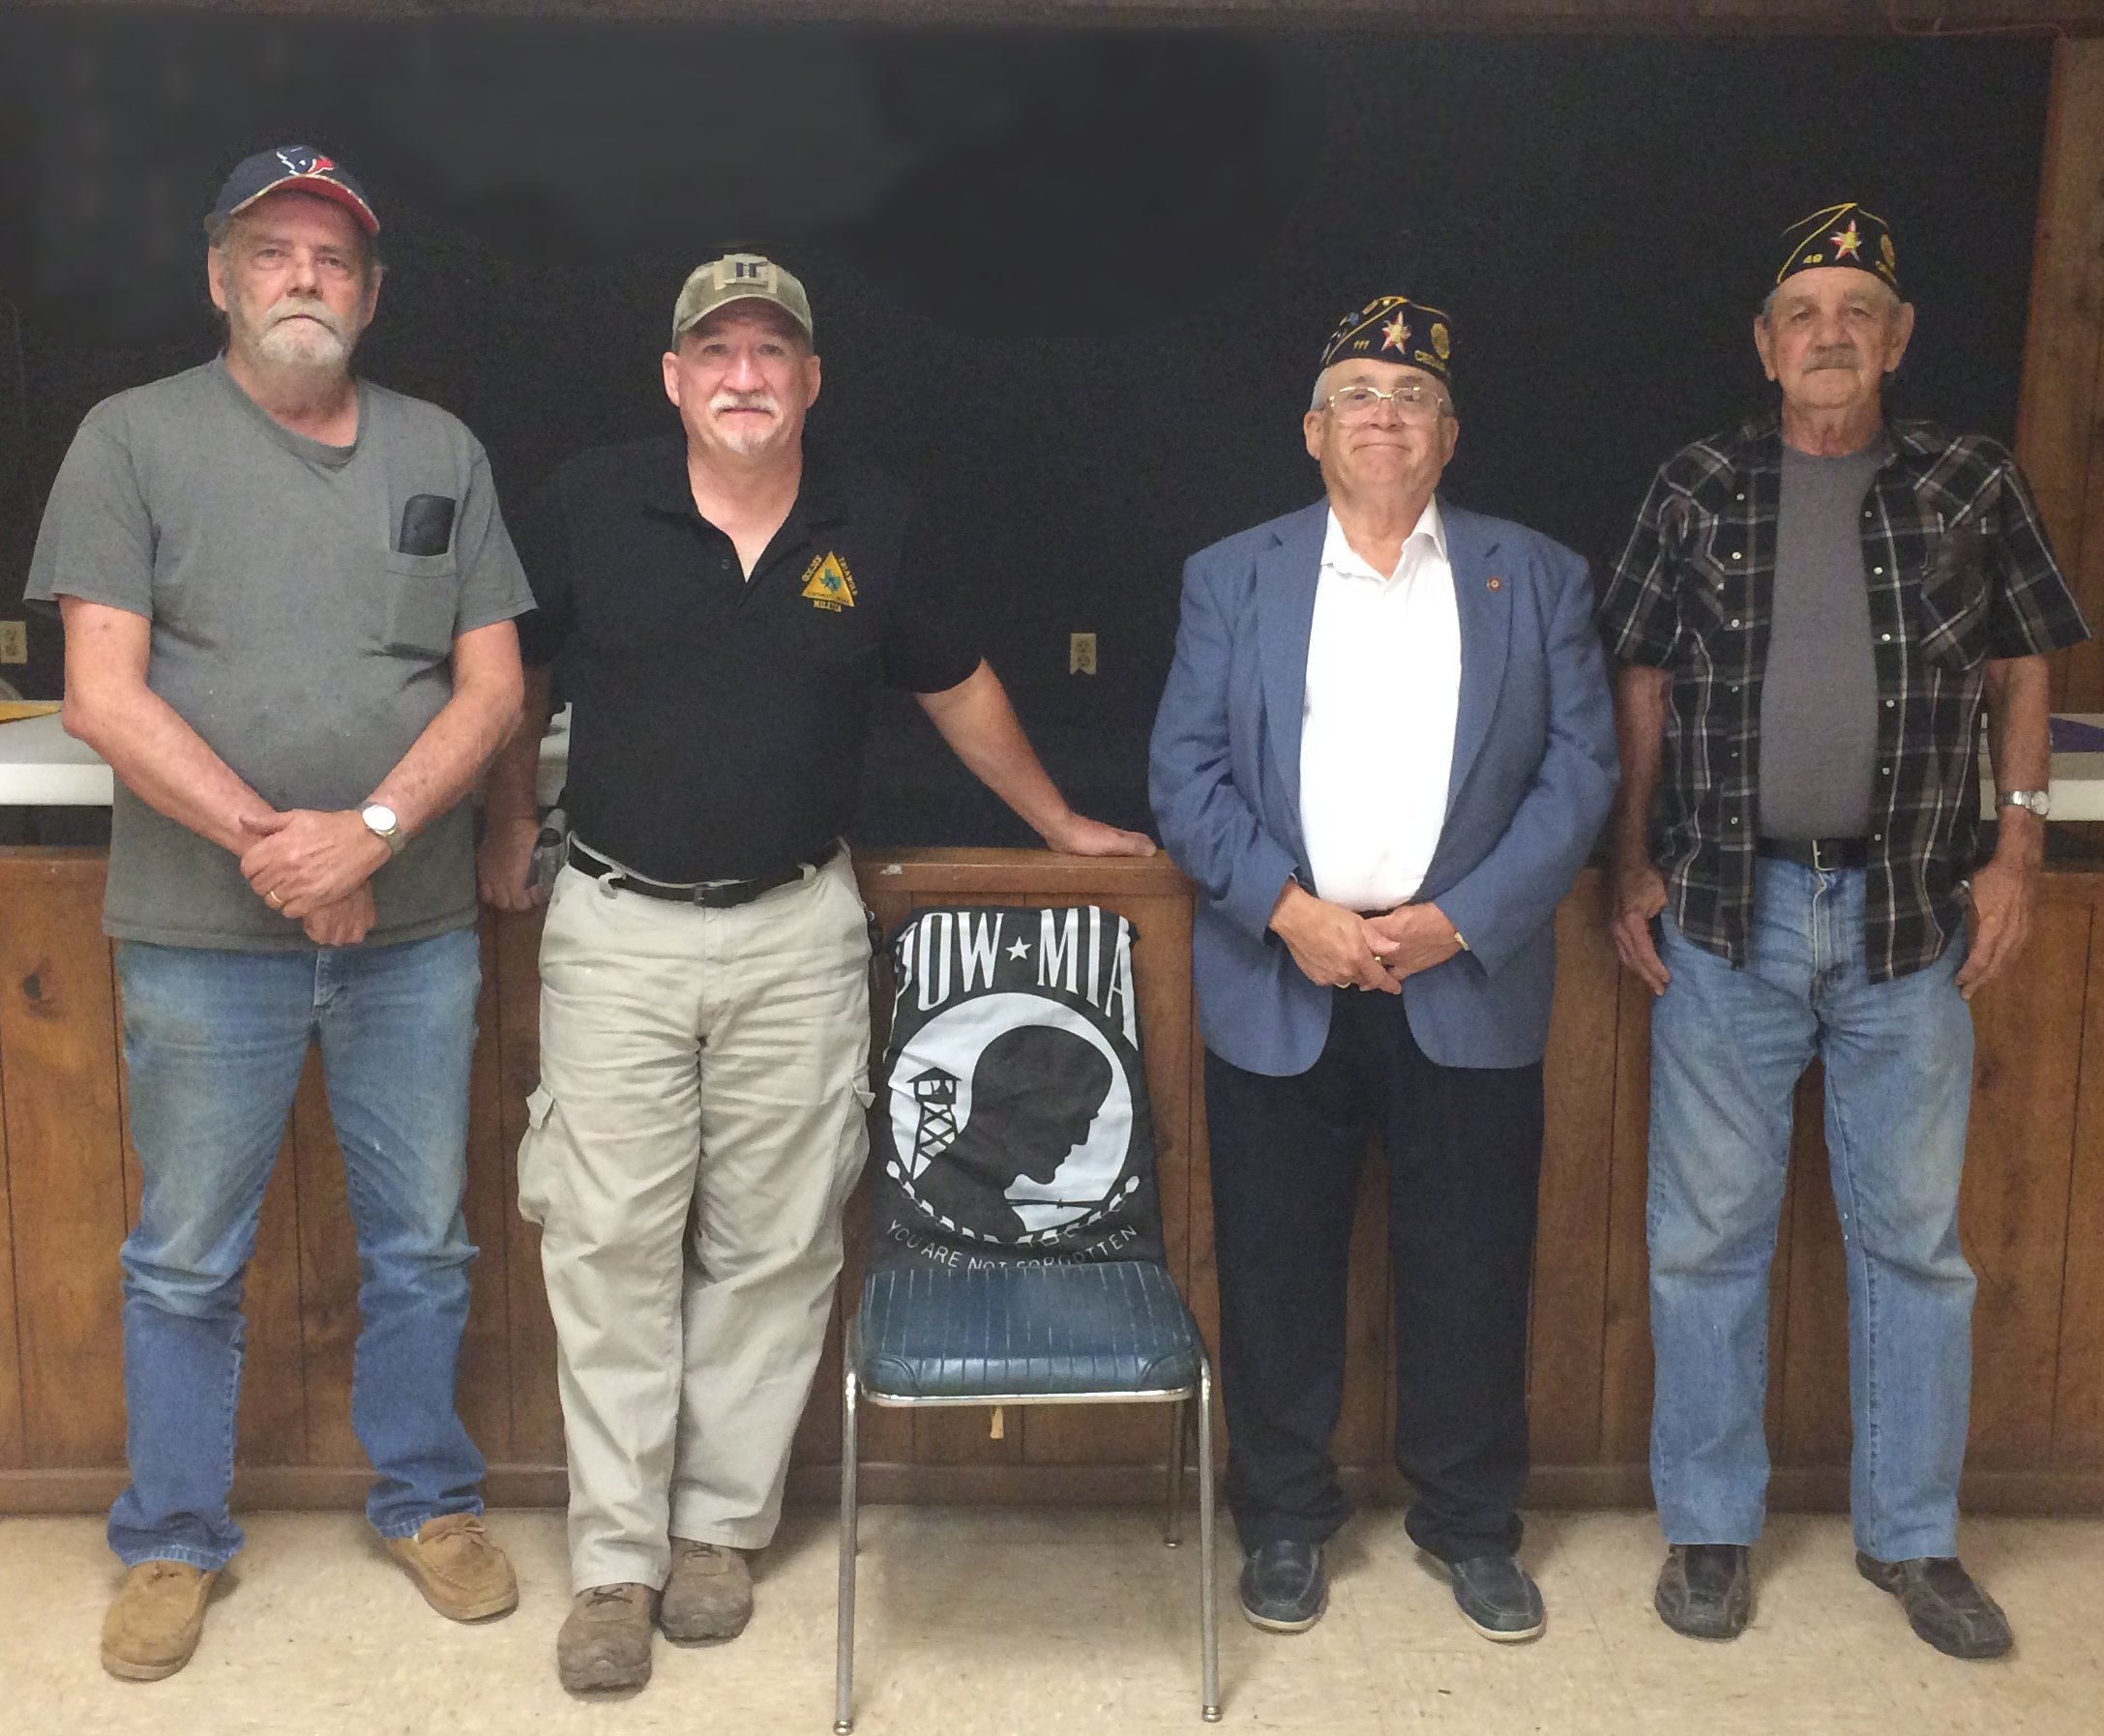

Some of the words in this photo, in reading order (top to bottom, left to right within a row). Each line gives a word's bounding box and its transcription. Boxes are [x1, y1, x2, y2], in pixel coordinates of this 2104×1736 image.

[1037, 905, 1139, 1051] MIA
[885, 1220, 919, 1249] YOU
[920, 1242, 963, 1269] ARE
